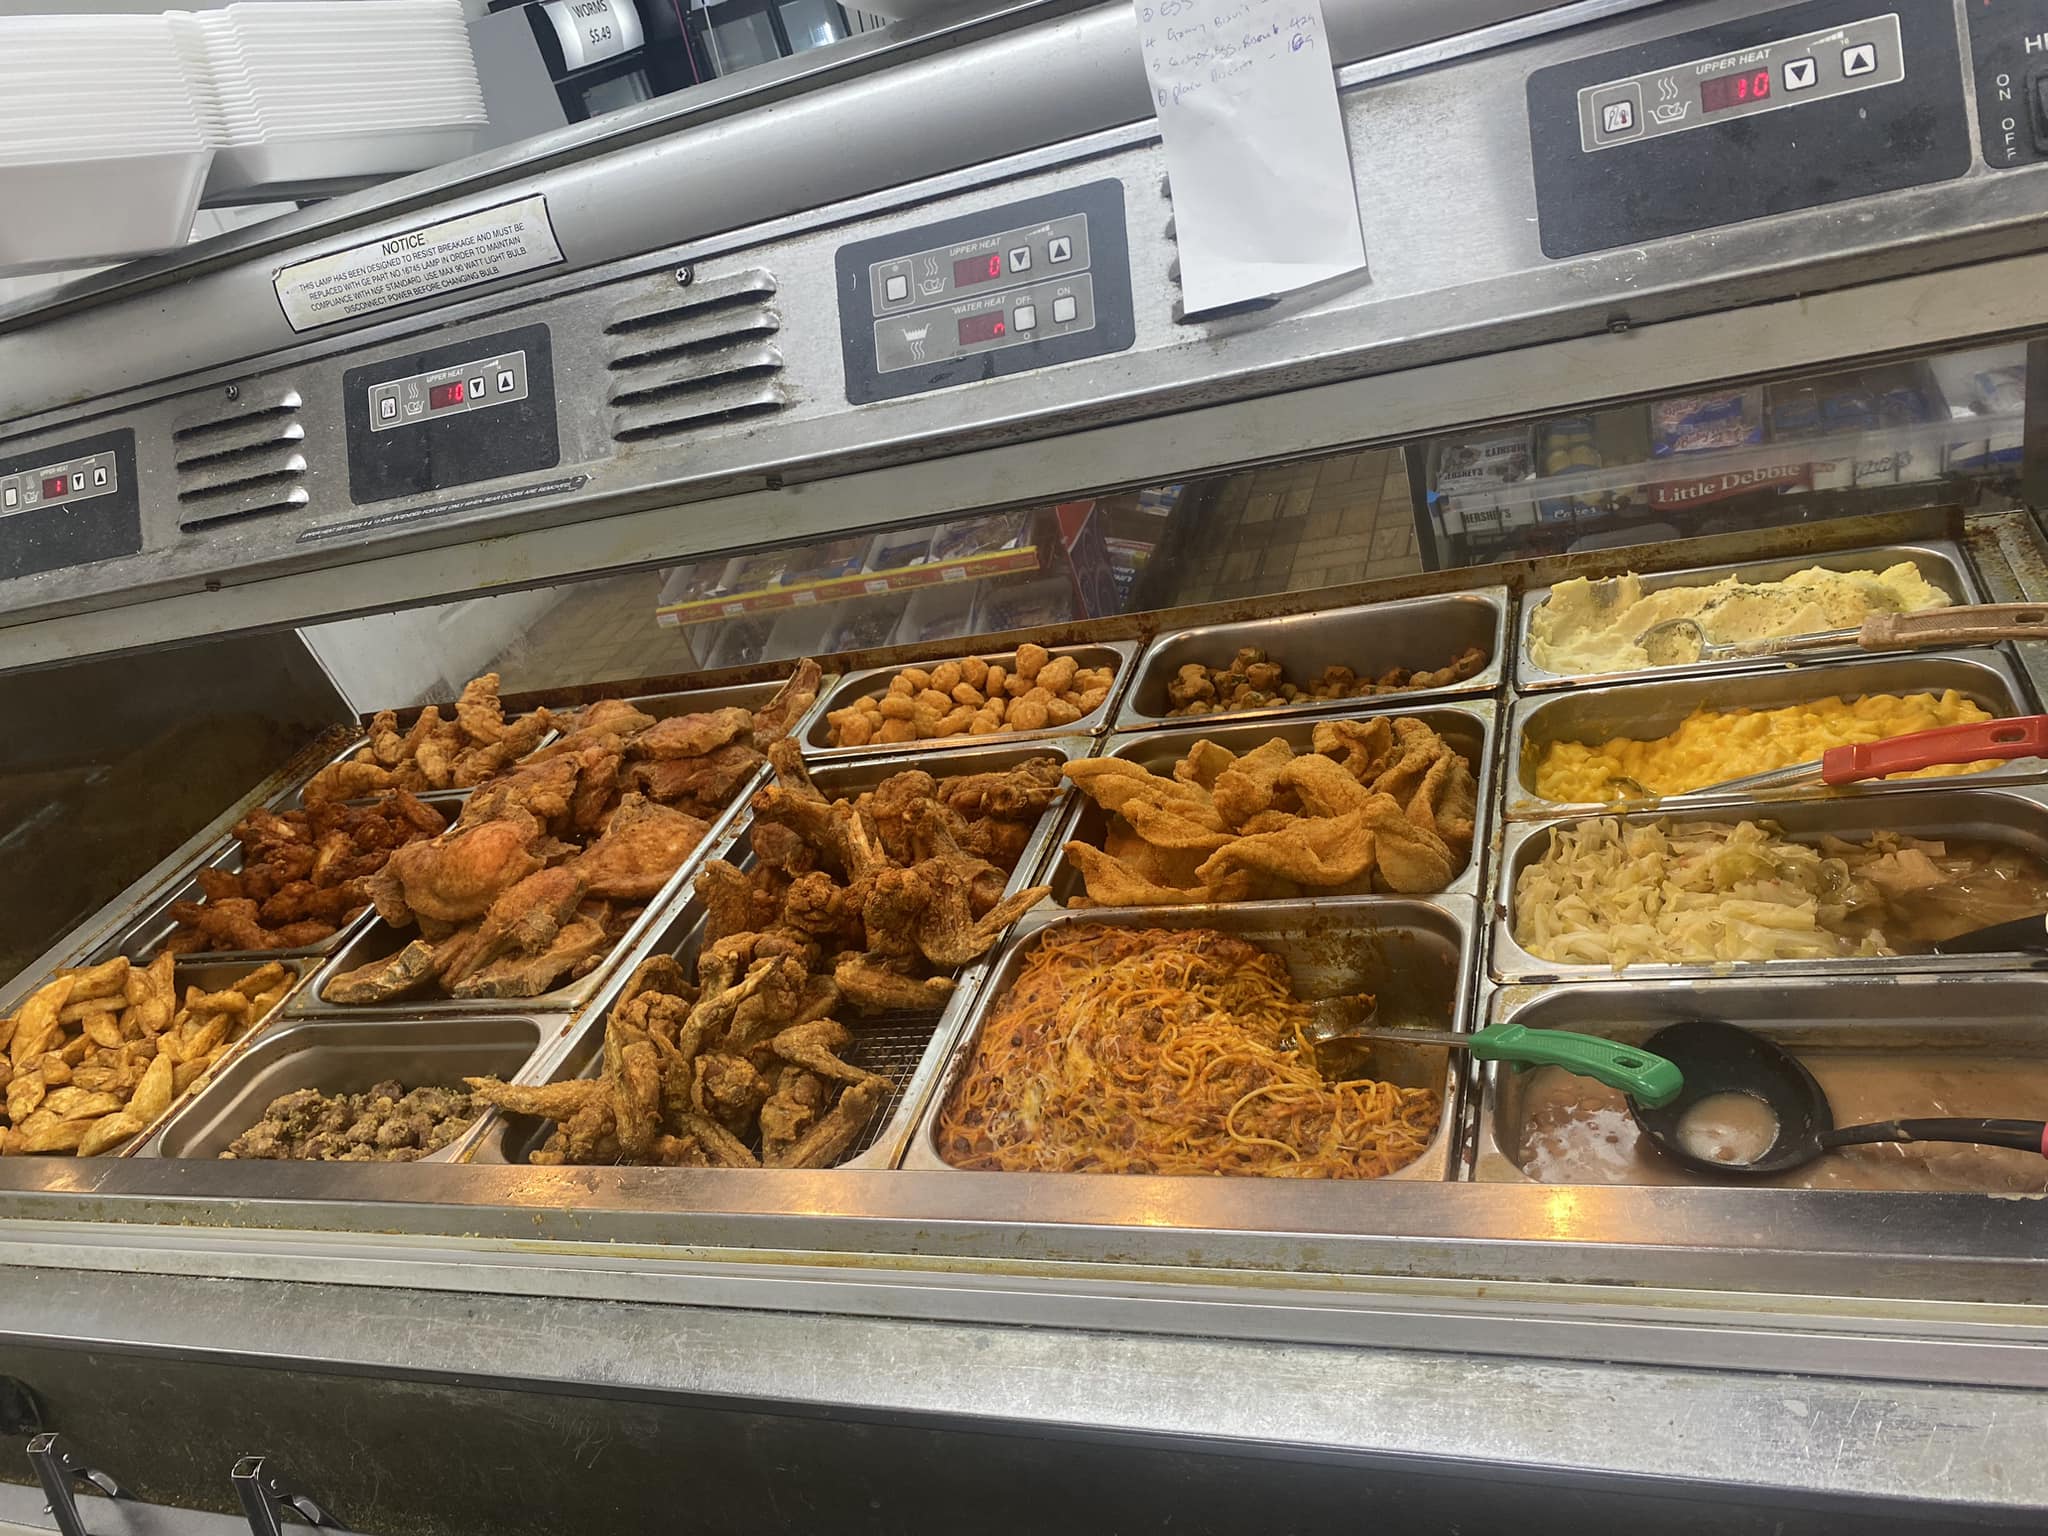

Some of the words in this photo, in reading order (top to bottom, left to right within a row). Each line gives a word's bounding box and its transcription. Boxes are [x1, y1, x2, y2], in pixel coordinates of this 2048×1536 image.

[571, 0, 608, 18] WORMS
[589, 25, 612, 45] $5.49
[1695, 57, 1737, 75] UPPER
[1738, 49, 1772, 67] HEAT
[1736, 72, 1770, 99] 10
[1996, 73, 2012, 101] ON
[2001, 117, 2017, 161] OFF
[382, 232, 426, 256] NOTICE
[949, 243, 977, 257] UPPER
[979, 236, 1001, 249] HEAT
[299, 281, 315, 293] THIS
[315, 276, 333, 288] LAMP
[333, 273, 348, 283] HAS
[348, 266, 367, 279] BEEN
[366, 257, 401, 273] DESIGNED
[401, 252, 413, 263] TO
[412, 246, 437, 260] RESIST
[437, 236, 476, 254] BREAKAGE
[476, 231, 492, 242] AND
[492, 225, 514, 238] MUST
[513, 222, 525, 233] BE
[309, 285, 344, 301] REPLACED
[343, 279, 361, 291] WITH
[360, 277, 372, 288] GE
[371, 272, 390, 284] PART
[421, 258, 442, 270] LAMP
[441, 256, 450, 265] IN
[449, 248, 475, 262] ORDER
[475, 245, 486, 255] TO
[486, 235, 521, 252] MAINTAIN
[310, 294, 353, 312] COMPLIANCE
[353, 288, 372, 300] WITH
[371, 285, 385, 296] NSF
[423, 271, 438, 281] USE
[438, 266, 455, 277] MAX
[454, 263, 465, 273] 90
[464, 258, 484, 271] WATT
[484, 252, 507, 265] LIGHT
[343, 296, 388, 314] DISCONNECT
[388, 288, 414, 304] POWER
[413, 280, 441, 296] BEFORE
[440, 271, 480, 288] CHANGING
[1057, 286, 1071, 296] ON
[953, 300, 983, 315] WATER
[984, 296, 1007, 308] HEAT
[1016, 296, 1032, 306] OFF
[426, 373, 447, 383] UPPER
[447, 369, 465, 378] HEAT
[1658, 482, 1716, 503] Little
[1720, 463, 1801, 490] Debbie
